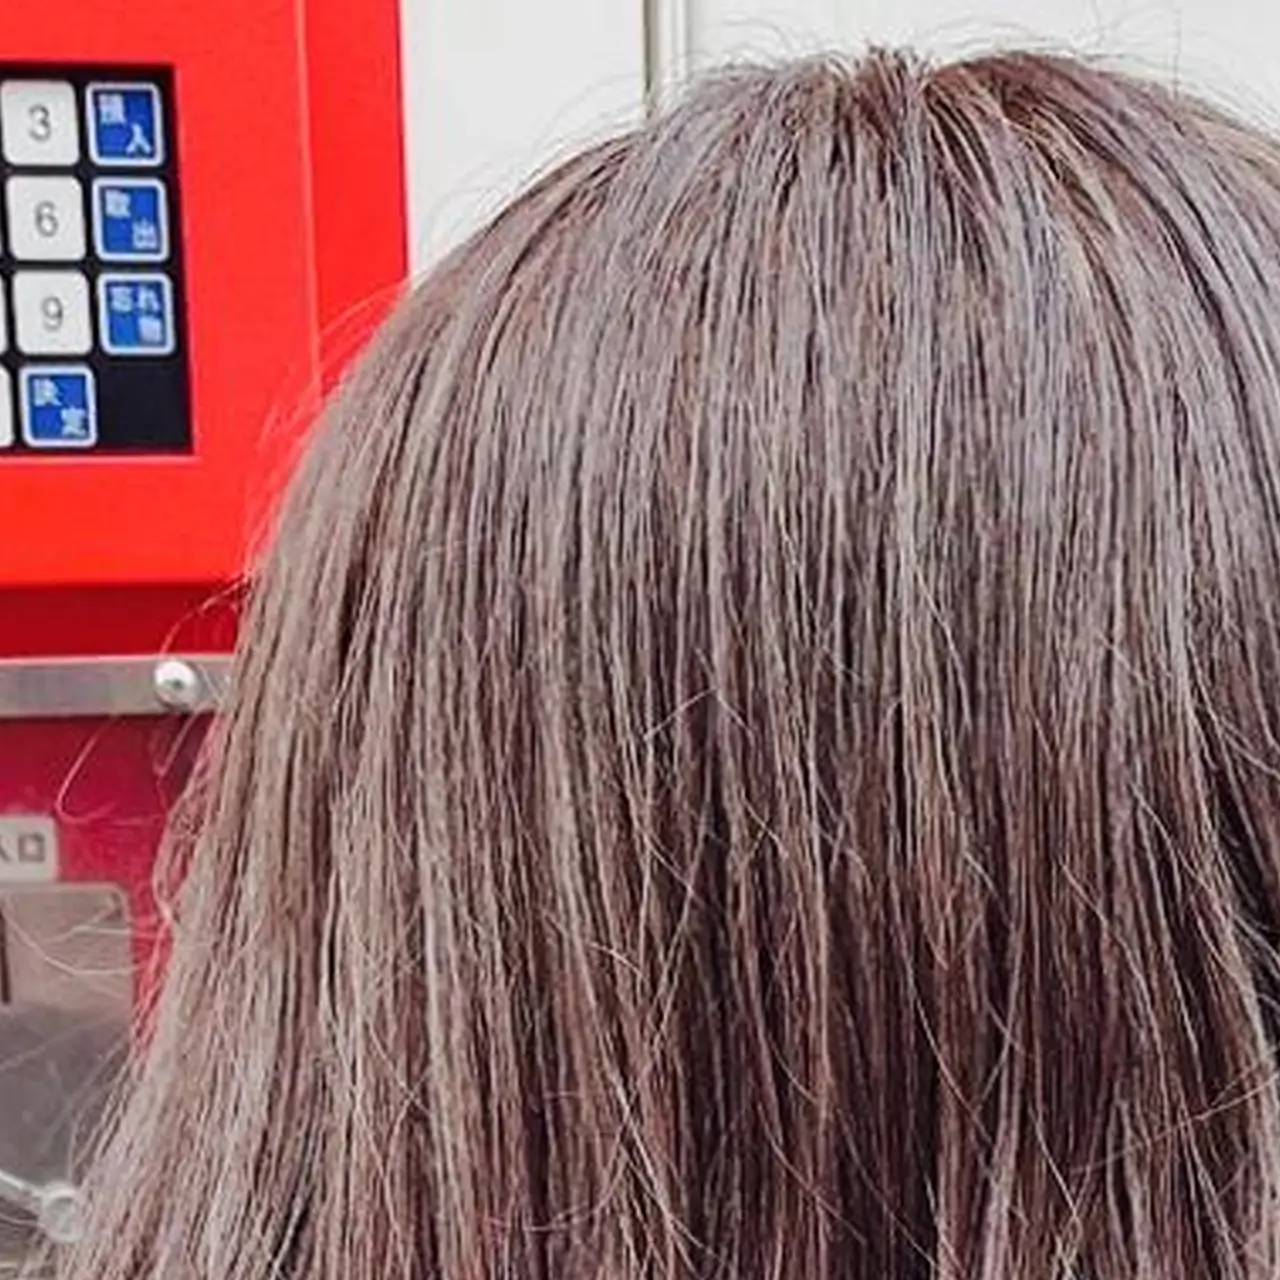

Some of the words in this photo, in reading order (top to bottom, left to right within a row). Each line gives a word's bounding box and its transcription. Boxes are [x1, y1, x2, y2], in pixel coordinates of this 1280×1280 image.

[30, 106, 51, 140] 3
[36, 202, 58, 237] 6
[42, 298, 64, 331] 9
